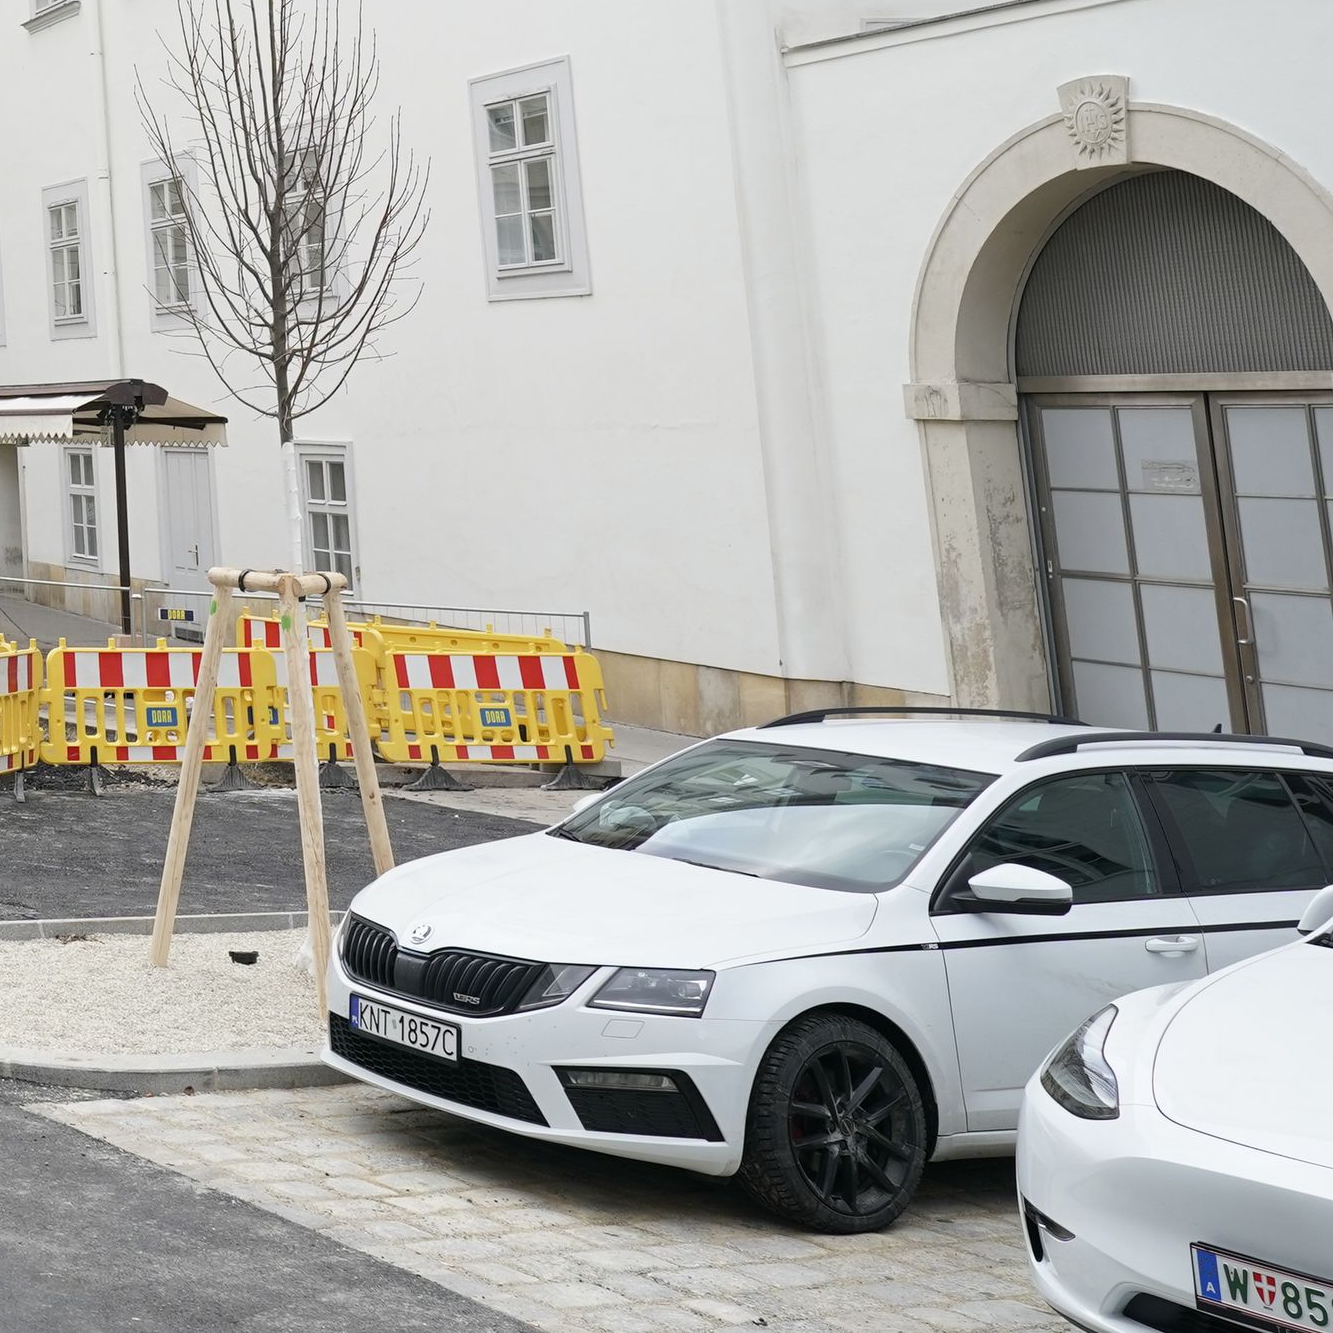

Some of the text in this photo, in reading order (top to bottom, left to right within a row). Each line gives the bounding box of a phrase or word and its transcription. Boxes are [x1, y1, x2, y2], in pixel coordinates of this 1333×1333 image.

[359, 1001, 455, 1056] KNT 1857C
[1206, 1281, 1216, 1294] A
[1223, 1263, 1249, 1304] W
